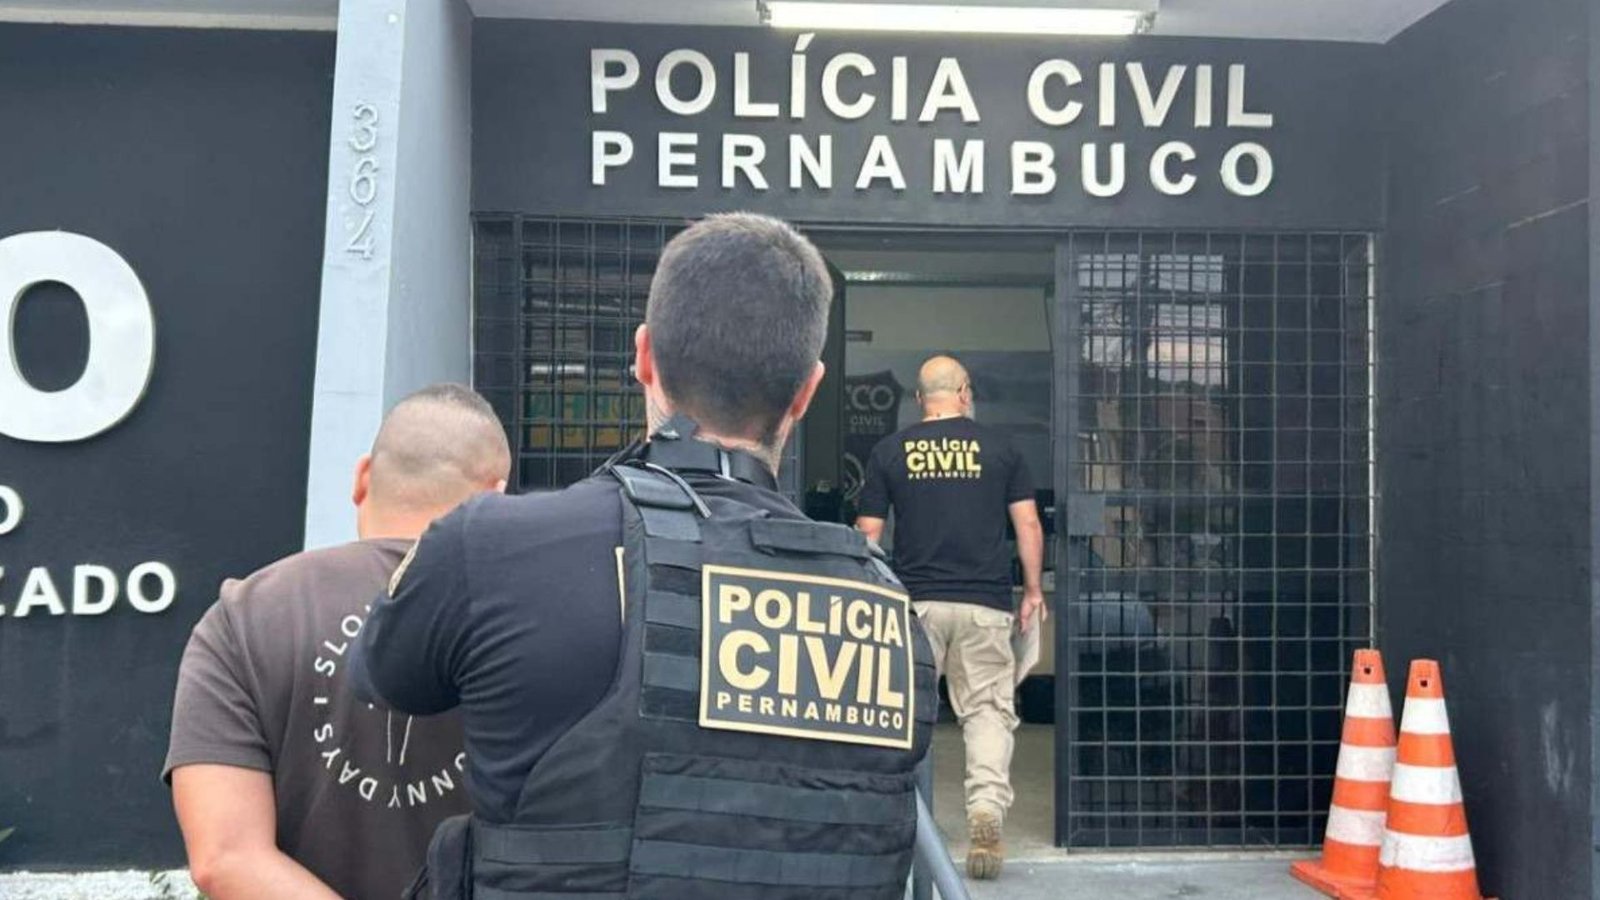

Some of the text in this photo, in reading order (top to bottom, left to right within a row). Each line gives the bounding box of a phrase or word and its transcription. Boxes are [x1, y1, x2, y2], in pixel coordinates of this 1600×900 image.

[590, 34, 1273, 128] POLÍCIA CIVIL
[348, 103, 378, 260] 364
[591, 130, 1274, 197] PERNAMBUCO
[905, 437, 981, 453] POLÍCIA
[906, 451, 982, 472] CIVIL
[0, 561, 176, 617] ADO
[719, 584, 903, 647] POLÍCIA
[315, 604, 371, 676] SLO
[718, 630, 904, 708] CIVIL
[717, 692, 903, 730] PERNAMBUCO
[314, 723, 378, 801] DAYS
